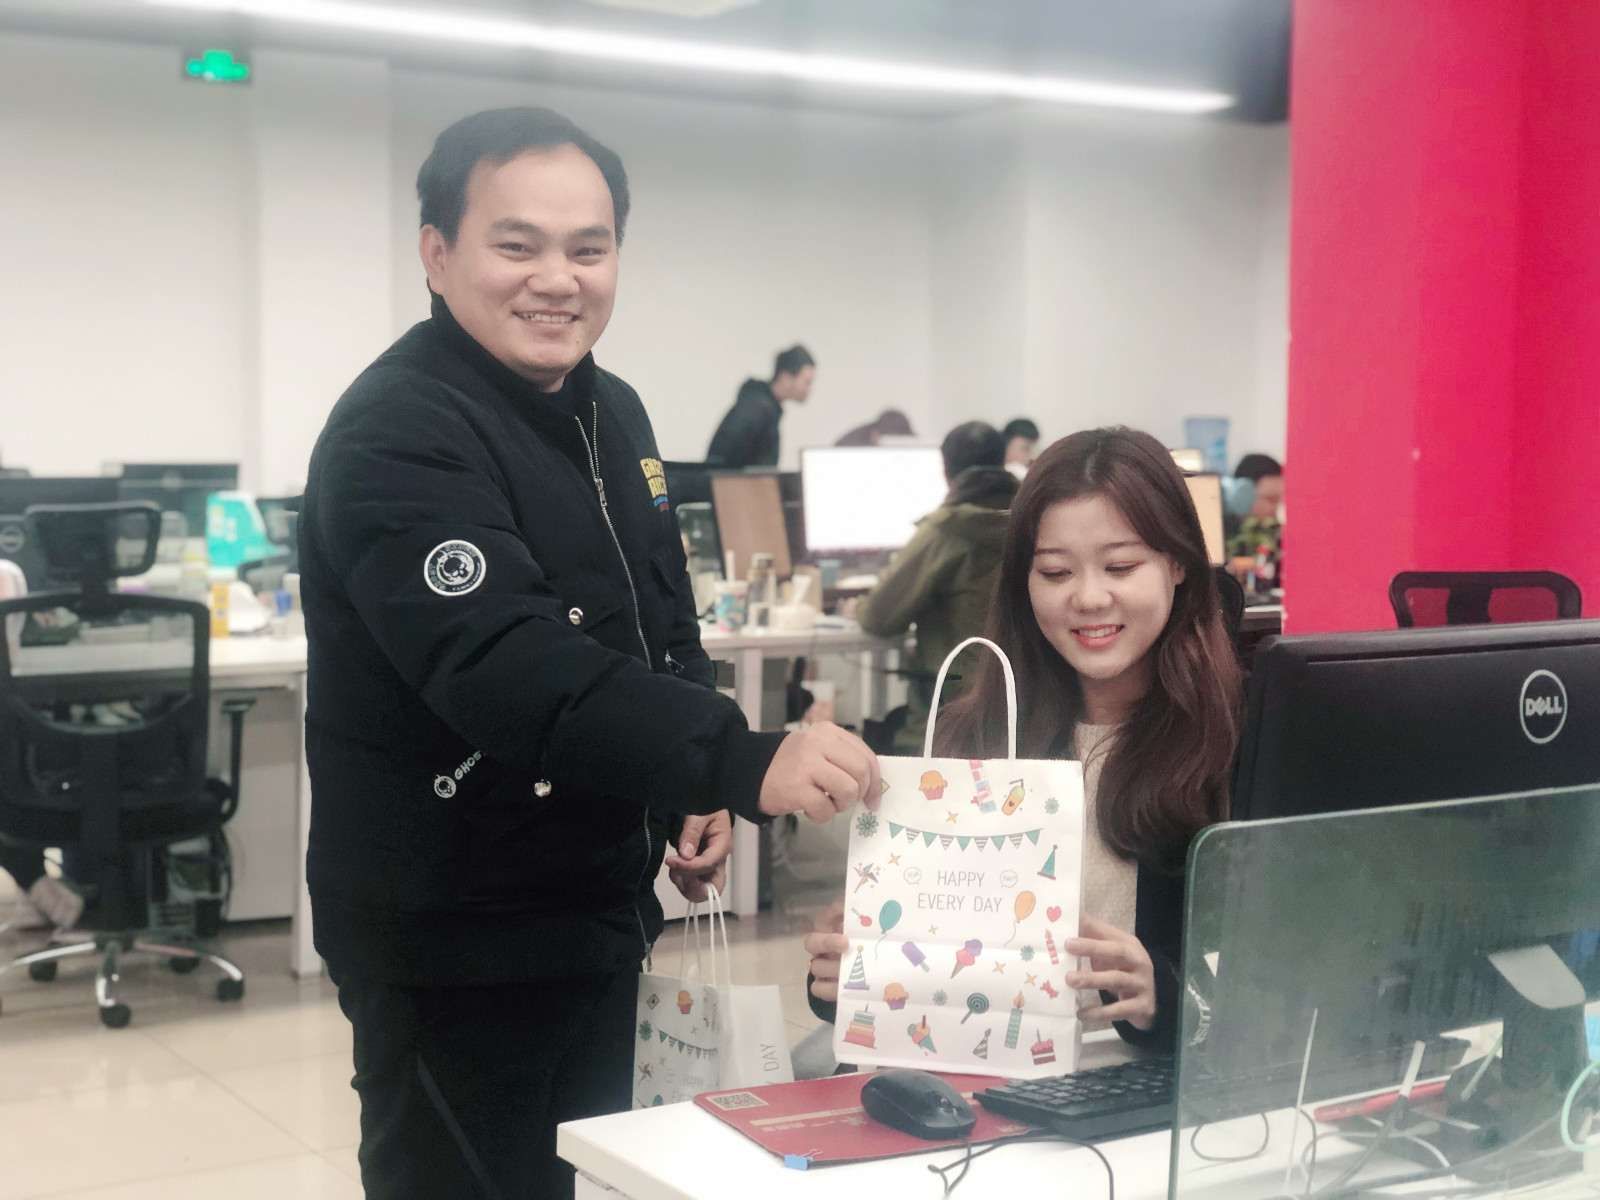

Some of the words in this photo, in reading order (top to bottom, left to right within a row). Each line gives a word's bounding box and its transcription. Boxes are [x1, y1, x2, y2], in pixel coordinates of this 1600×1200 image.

[1525, 695, 1563, 717] DELL
[937, 869, 986, 888] HAPPY
[917, 892, 966, 911] EVERY
[973, 895, 1003, 913] DAY
[760, 1043, 780, 1072] DAY
